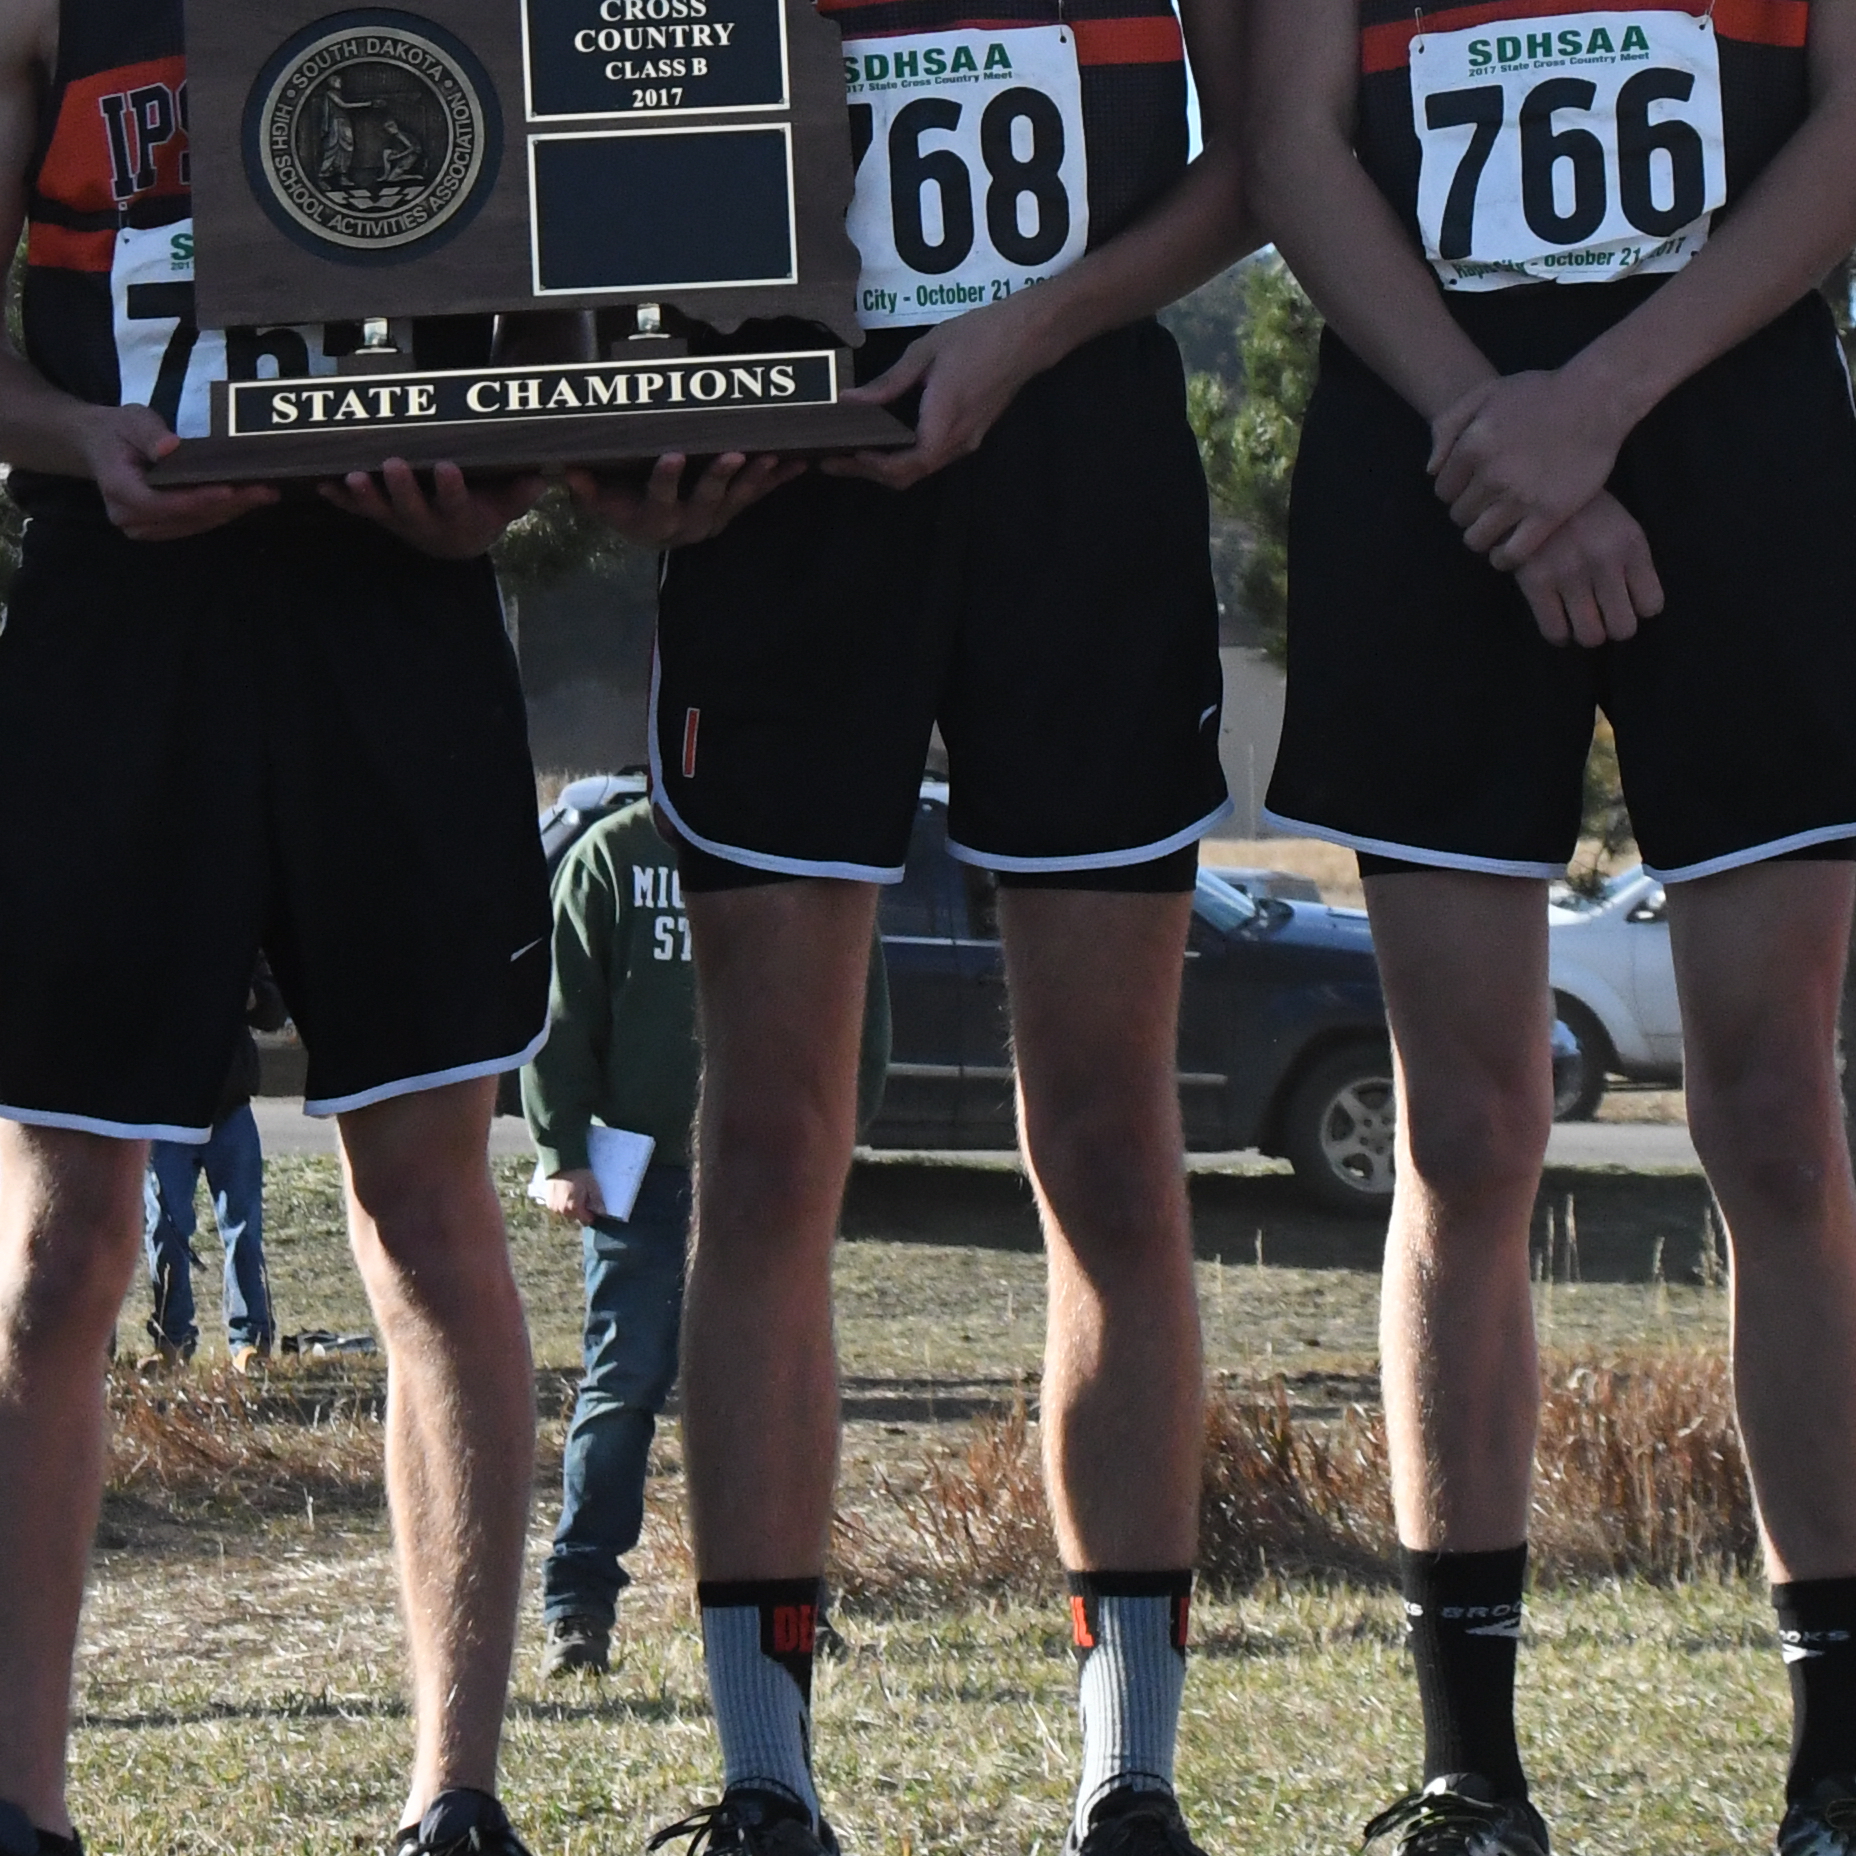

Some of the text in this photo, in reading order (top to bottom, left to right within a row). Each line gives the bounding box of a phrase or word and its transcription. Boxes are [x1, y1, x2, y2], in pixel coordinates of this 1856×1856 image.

[573, 22, 736, 53] COUNTRY
[1467, 25, 1650, 67] SDHSAA
[292, 37, 446, 89] SOUTH DAKOTA
[605, 57, 709, 80] CLASS B
[843, 42, 1013, 84] SDHSAA
[1468, 51, 1650, 78] 2017 State Cross Country Meet
[632, 87, 684, 108] 2017
[846, 70, 1013, 94] 017 State Cross Country Meet
[271, 85, 473, 236] HIGH SCHOOL ACTIVITIES ASSOCIATION
[1424, 67, 1707, 261] 766
[848, 86, 1070, 276] 68
[1544, 247, 1615, 268] October
[863, 288, 898, 315] City
[916, 282, 986, 307] October
[271, 364, 797, 425] STATE CHAMPIONS
